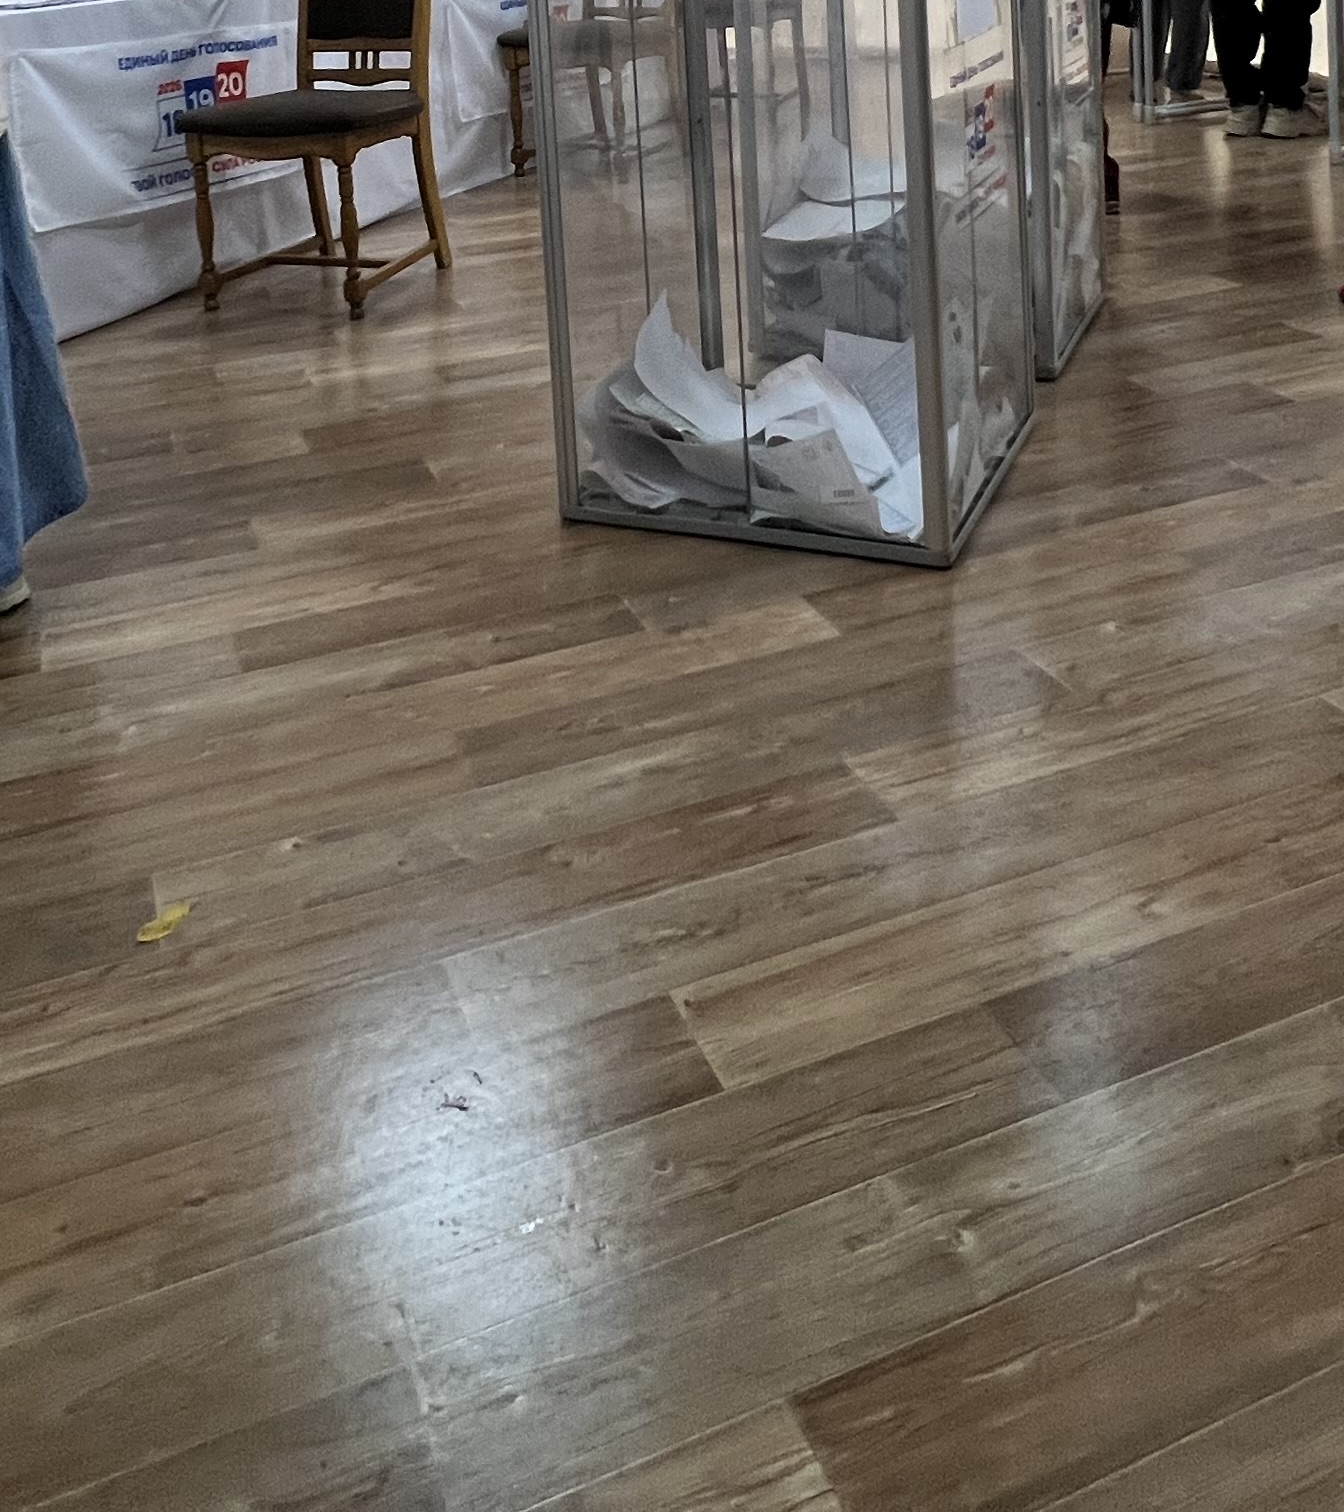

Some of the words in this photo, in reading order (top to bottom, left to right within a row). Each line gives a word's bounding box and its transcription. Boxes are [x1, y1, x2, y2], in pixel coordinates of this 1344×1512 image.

[118, 49, 170, 71] ЕДИНЫЙ
[171, 46, 197, 63] ДЕНЬ
[197, 35, 278, 57] ГОЛОСОВАНИЯ
[217, 71, 244, 99] 20
[158, 168, 194, 187] ГОЛО
